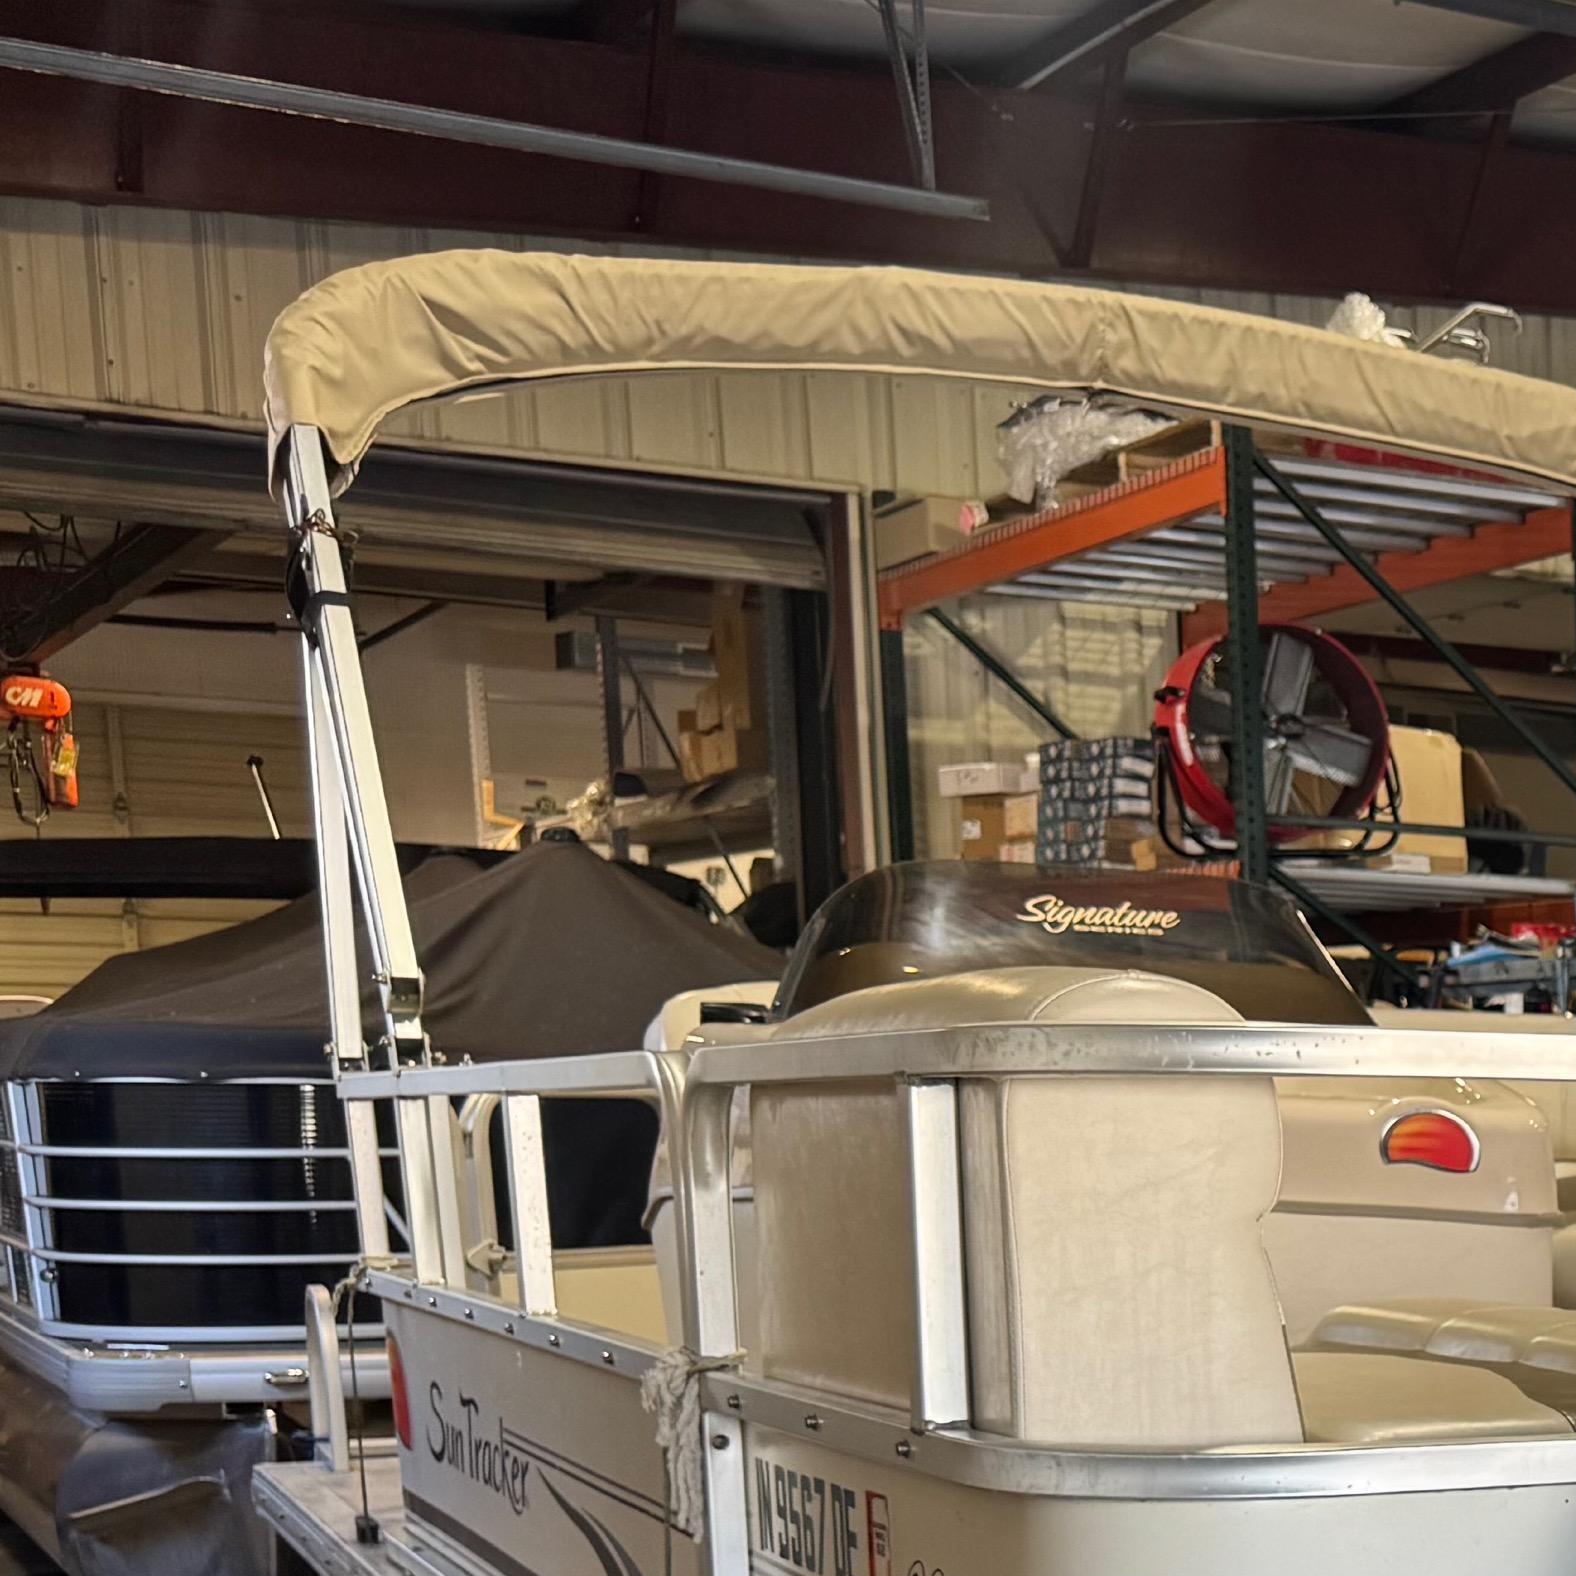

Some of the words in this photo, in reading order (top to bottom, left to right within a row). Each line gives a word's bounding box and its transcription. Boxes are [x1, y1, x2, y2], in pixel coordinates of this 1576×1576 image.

[5, 686, 44, 708] CM
[1016, 894, 1181, 935] Signature
[755, 1457, 774, 1553] IN
[775, 1463, 825, 1576] 9567
